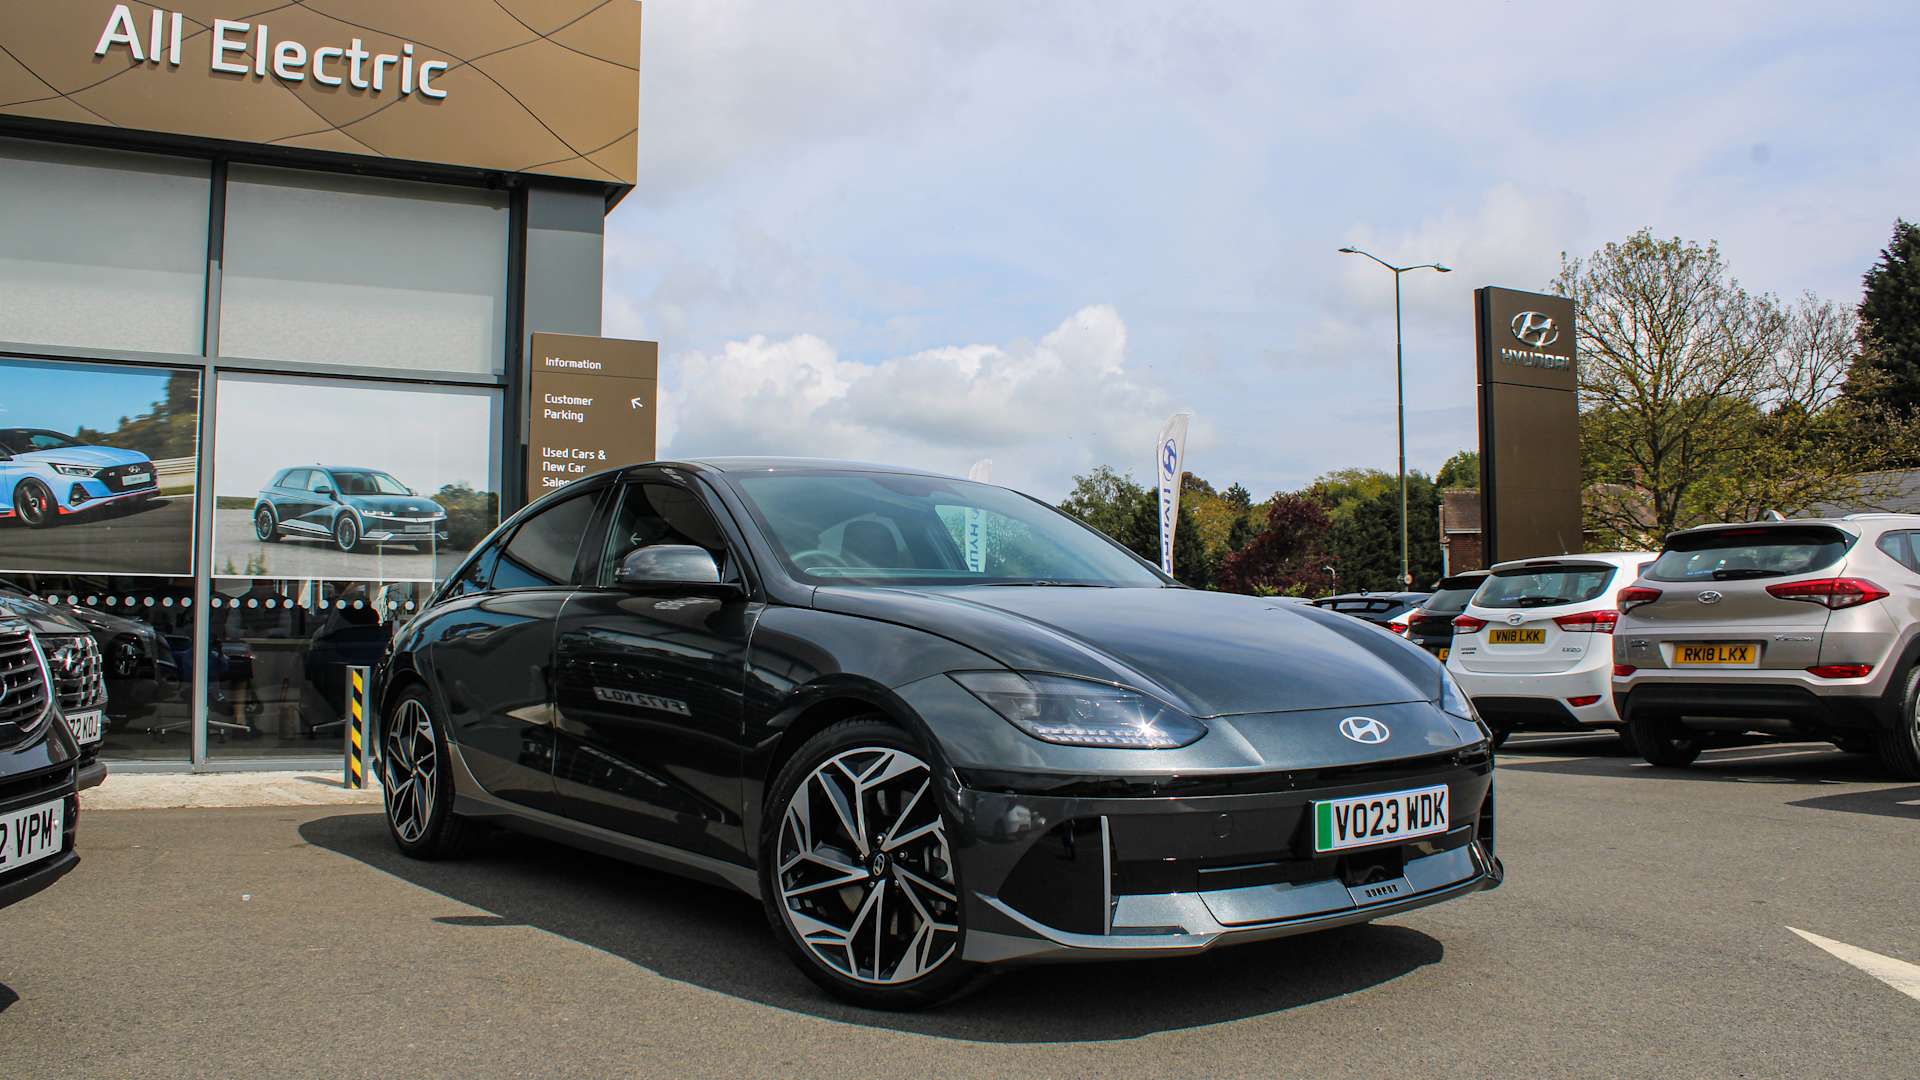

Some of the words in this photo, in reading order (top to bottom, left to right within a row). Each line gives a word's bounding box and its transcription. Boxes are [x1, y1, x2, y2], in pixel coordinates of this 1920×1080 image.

[94, 4, 183, 65] All
[212, 19, 449, 98] Electric
[545, 356, 602, 370] Information
[1501, 347, 1570, 369] HYUNDAI
[544, 393, 593, 406] Customer
[544, 408, 584, 423] Parking
[542, 447, 569, 458] Used
[571, 448, 595, 460] Cars
[597, 450, 606, 460] &
[542, 461, 566, 472] New
[568, 462, 586, 473] Car
[1495, 631, 1516, 641] VN18
[1519, 630, 1540, 641] LKK
[1683, 647, 1715, 661] RK18
[1719, 647, 1748, 661] LKX
[82, 714, 99, 739] KOJ
[1335, 799, 1399, 841] VO23
[1406, 791, 1446, 831] WDK
[16, 808, 55, 858] VPM
